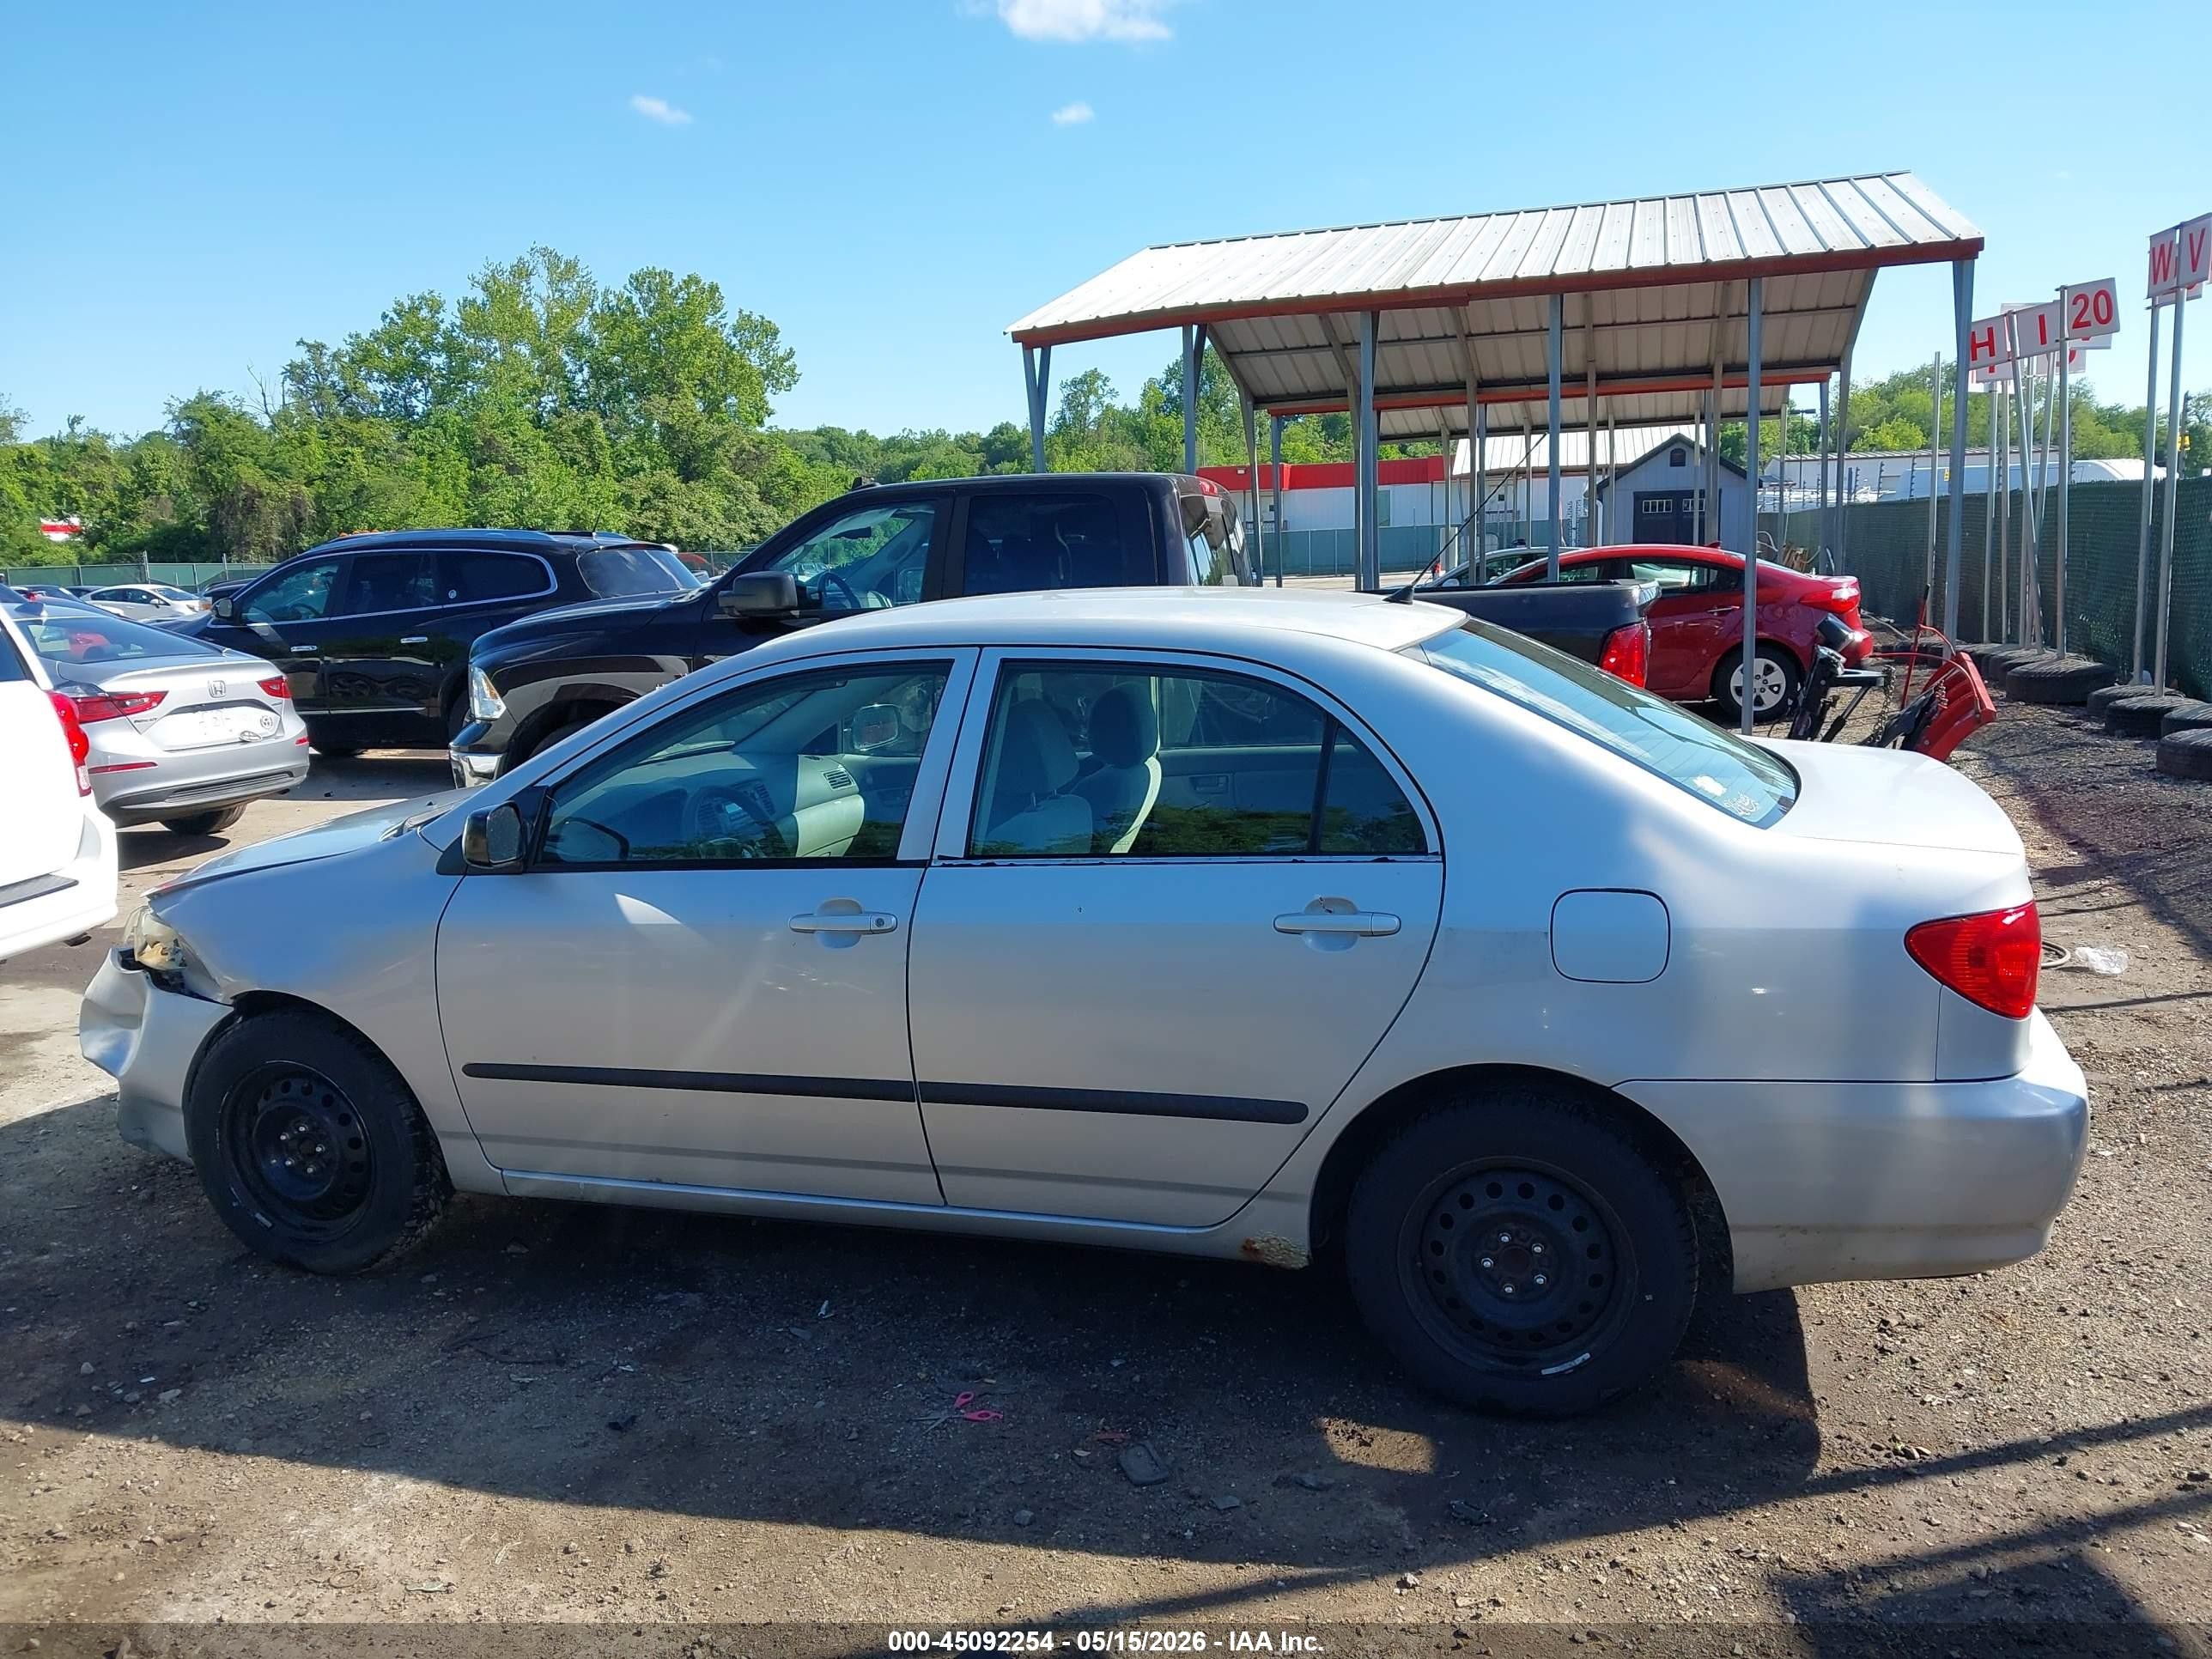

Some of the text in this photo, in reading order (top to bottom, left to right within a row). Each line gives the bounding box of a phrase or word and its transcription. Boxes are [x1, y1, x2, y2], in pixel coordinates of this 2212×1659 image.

[2152, 240, 2173, 285] W
[2189, 228, 2206, 272] V
[2072, 289, 2113, 330] 20
[1971, 325, 1996, 362] H
